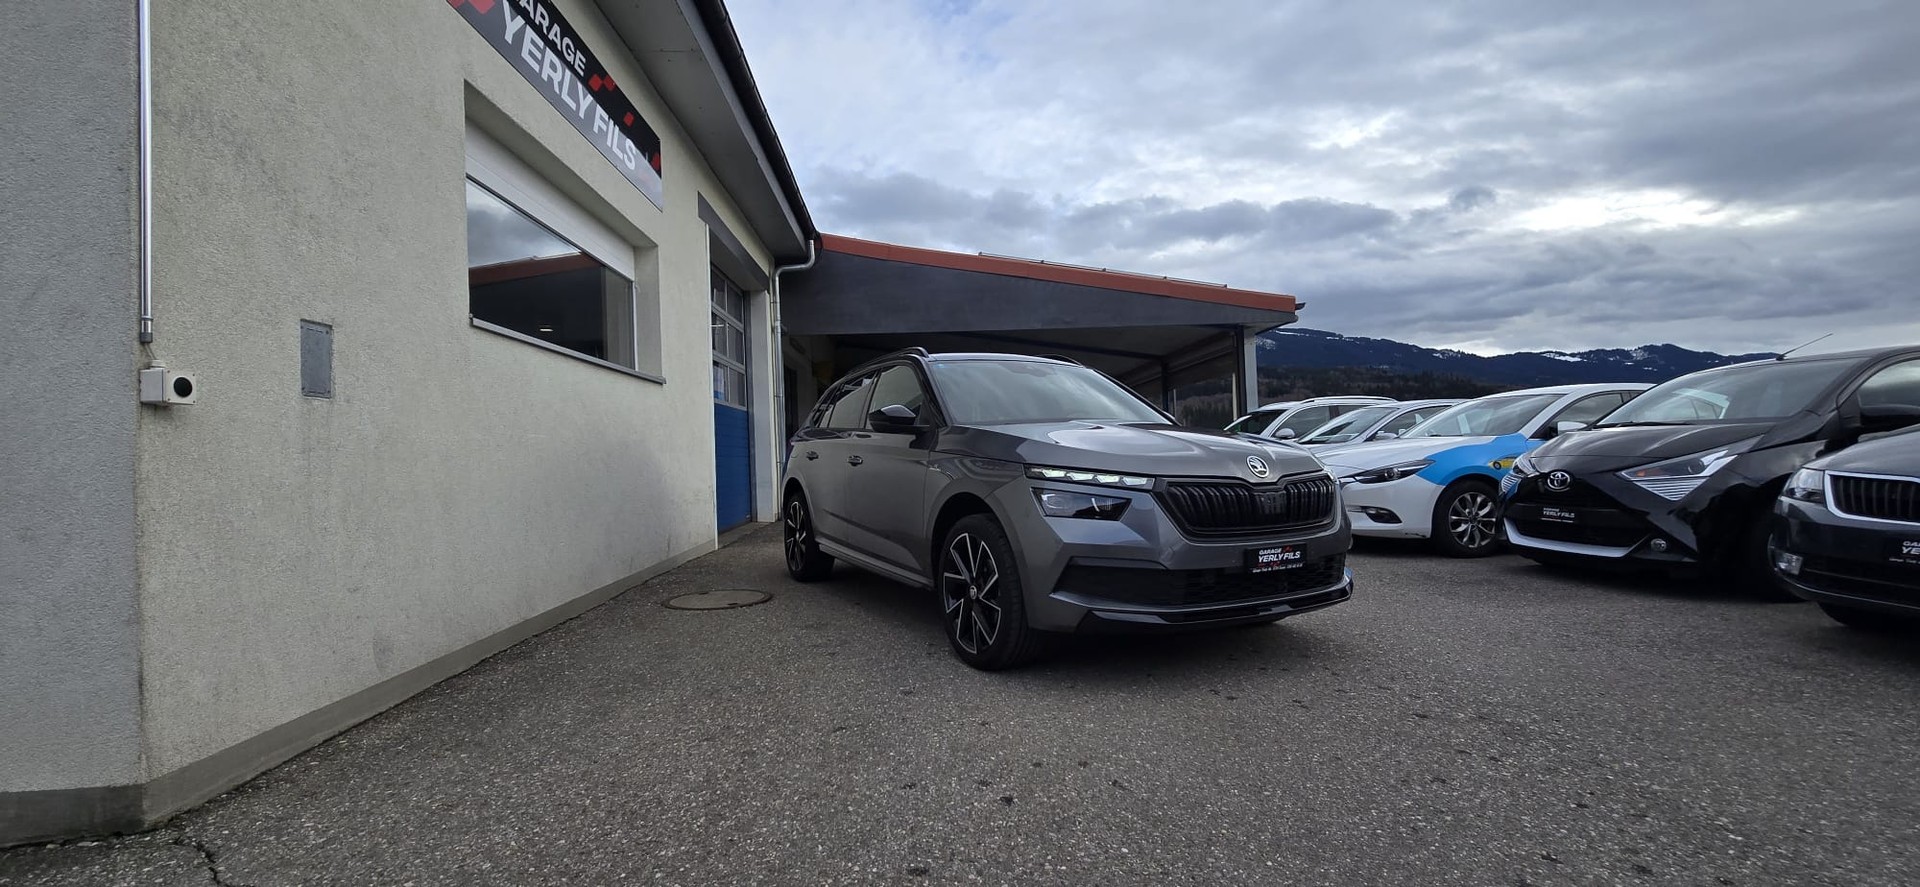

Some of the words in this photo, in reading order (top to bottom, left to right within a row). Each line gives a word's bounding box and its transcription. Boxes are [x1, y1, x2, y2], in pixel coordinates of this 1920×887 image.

[517, 0, 586, 77] ARAGE
[503, 0, 593, 119] YERLY
[593, 104, 637, 171] FILS
[1258, 553, 1283, 562] YERLY
[1283, 551, 1300, 559] FILS
